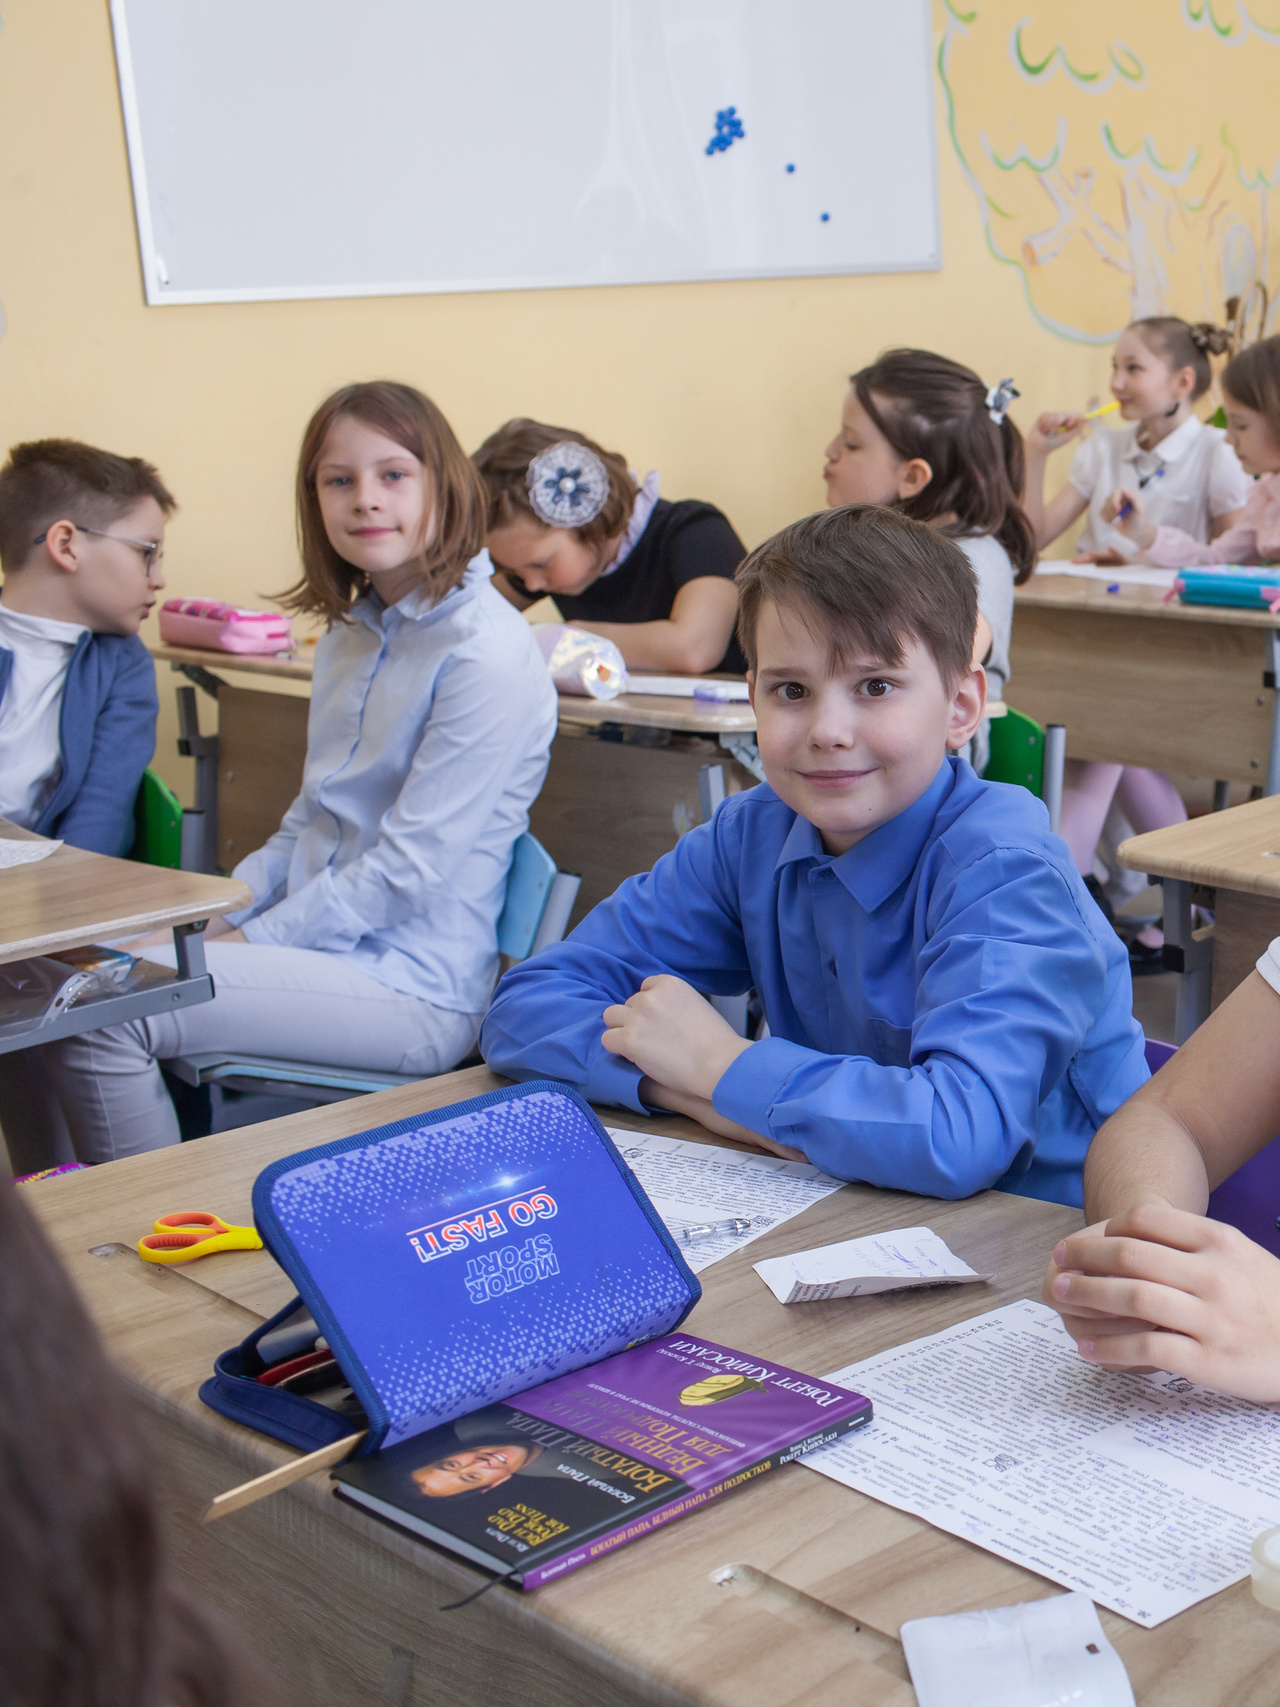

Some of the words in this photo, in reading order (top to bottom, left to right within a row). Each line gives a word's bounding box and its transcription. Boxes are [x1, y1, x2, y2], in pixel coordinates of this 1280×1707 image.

[508, 1193, 558, 1227] GO
[409, 1209, 508, 1263] FAST!
[464, 1234, 554, 1285] SPORT
[466, 1253, 561, 1304] MOTOR
[669, 1340, 776, 1382] КИЙОСАКИ
[770, 1376, 842, 1406] РОБЕРТ
[723, 1460, 771, 1489] ПОДРОСТКОВ
[487, 1514, 516, 1531] DAD
[497, 1507, 526, 1524] DAD
[523, 1519, 558, 1539] POOR
[512, 1527, 546, 1546] RICH
